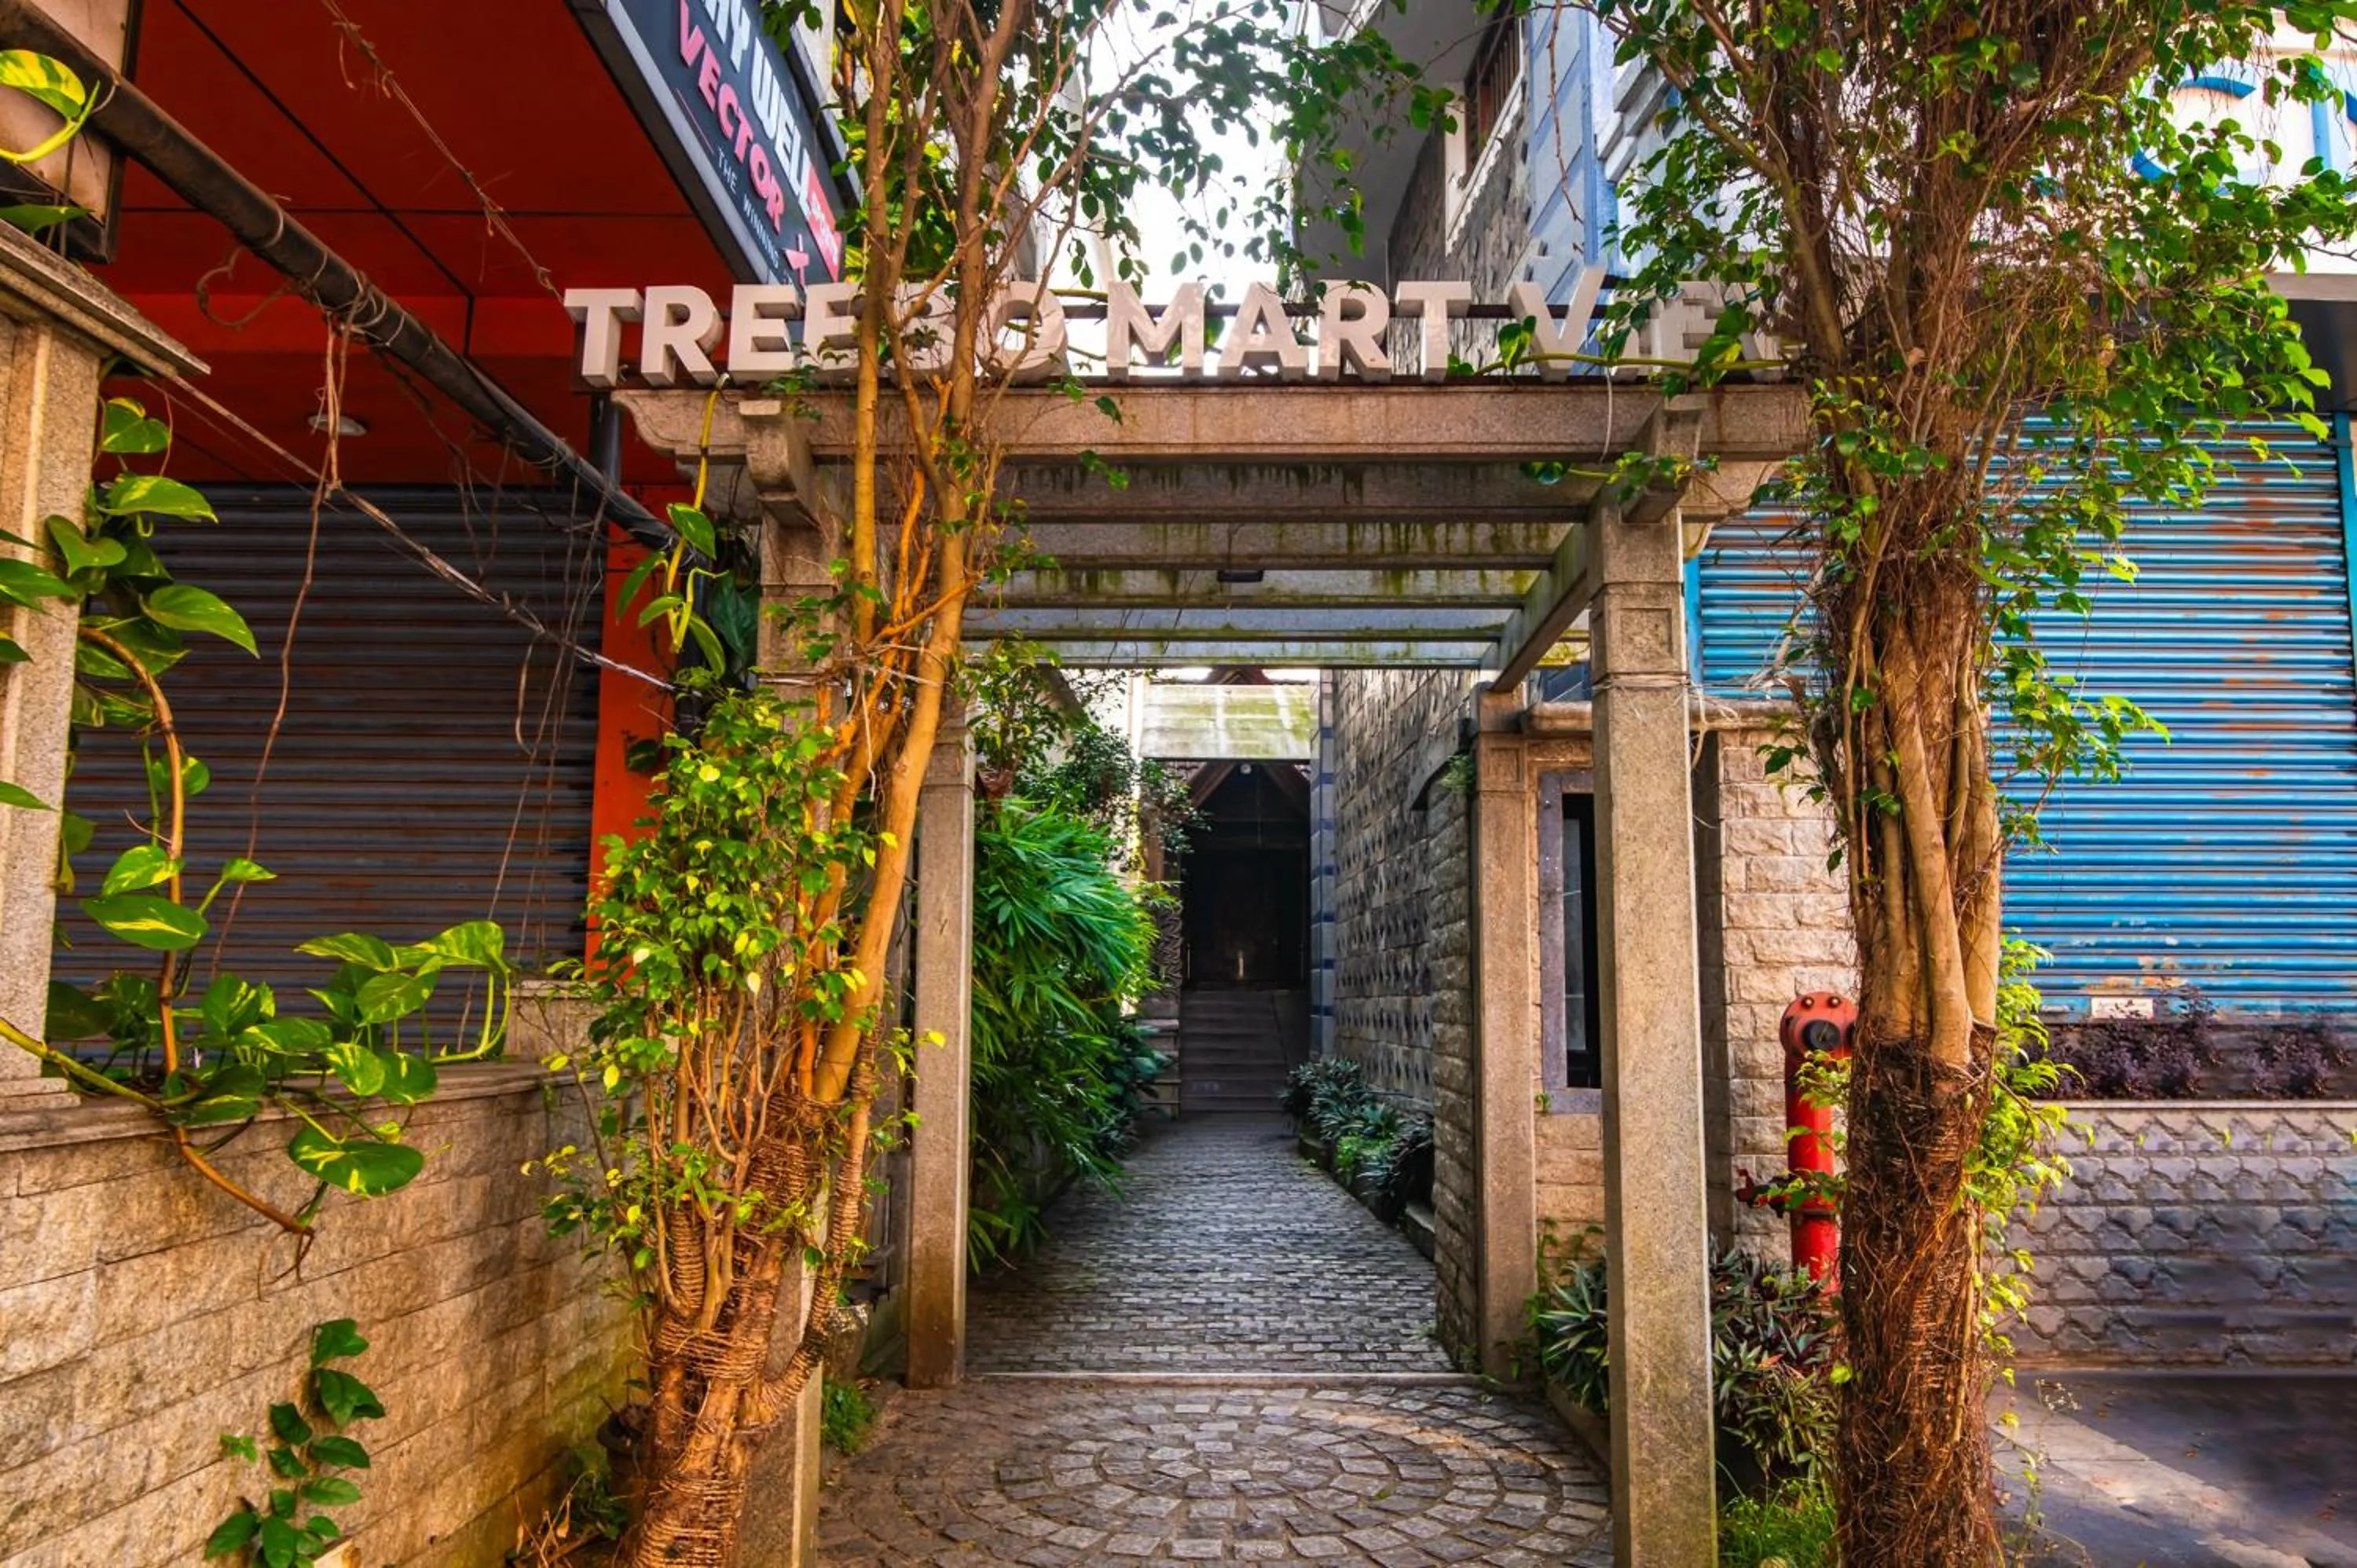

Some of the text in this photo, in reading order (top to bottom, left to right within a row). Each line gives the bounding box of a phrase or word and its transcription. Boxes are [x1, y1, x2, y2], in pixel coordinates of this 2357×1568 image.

[680, 0, 785, 235] VECTOR
[717, 147, 738, 195] THE
[563, 280, 1069, 387] TREEBO
[1105, 279, 1472, 383] MART
